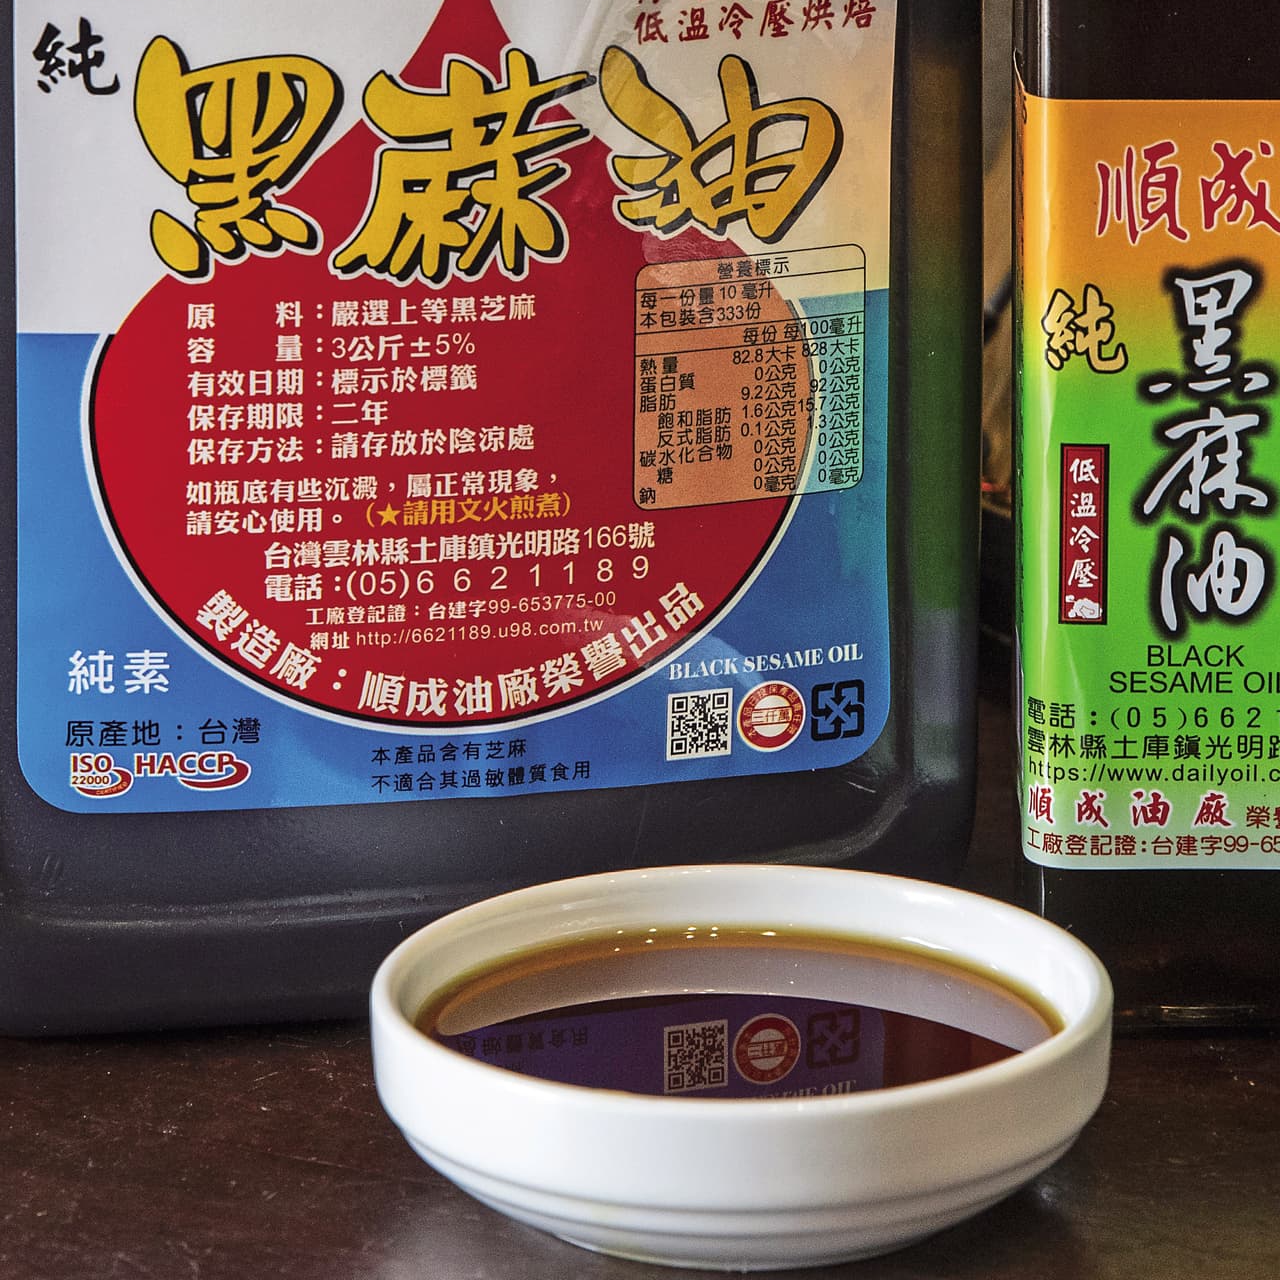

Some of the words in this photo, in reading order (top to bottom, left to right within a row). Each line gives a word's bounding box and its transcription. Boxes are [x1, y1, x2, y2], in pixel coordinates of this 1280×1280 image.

[33, 17, 120, 96] 純
[717, 256, 789, 280] 營養標示
[640, 302, 761, 329] 本包裝含333份
[743, 326, 777, 345] 每份
[784, 315, 862, 341] 每100毫升
[1041, 283, 1128, 374] 純
[640, 356, 678, 375] 熱量
[733, 345, 796, 365] 82.8大卡
[802, 338, 860, 357] 828大卡
[640, 373, 695, 394] 蛋白質
[754, 363, 796, 382] 0公克
[819, 356, 860, 375] 0公克
[640, 394, 676, 413] 脂肪
[741, 382, 796, 402] 9.2公克
[810, 374, 860, 394] 92公克
[657, 407, 731, 429] 飽和脂肪
[743, 400, 796, 419] 1.6公克
[798, 393, 860, 413] 15.7公克
[640, 444, 733, 468] 碳水化合物
[754, 437, 796, 456] 0公克
[818, 430, 859, 449] 0公克
[657, 426, 731, 448] 反式脂肪
[740, 418, 796, 438] 0.1公克
[657, 467, 673, 485] 糖
[754, 455, 796, 474] 0公克
[818, 448, 859, 467] 0公克
[640, 488, 656, 505] 鈉
[754, 474, 796, 493] 0毫克
[818, 466, 859, 485] 0毫克
[310, 631, 350, 651] 網址
[356, 619, 604, 648] http://6621189.u98.com.tw
[68, 650, 170, 695] 純素
[668, 656, 738, 681] BLACK
[742, 648, 824, 676] SESAME
[828, 643, 864, 668] OIL
[1147, 644, 1245, 667] BLACK
[1109, 671, 1233, 694] SESAME
[71, 754, 113, 773] ISO
[135, 752, 235, 775] HACCP
[371, 739, 527, 766] 本產品含有芝麻
[71, 775, 110, 785] 22000
